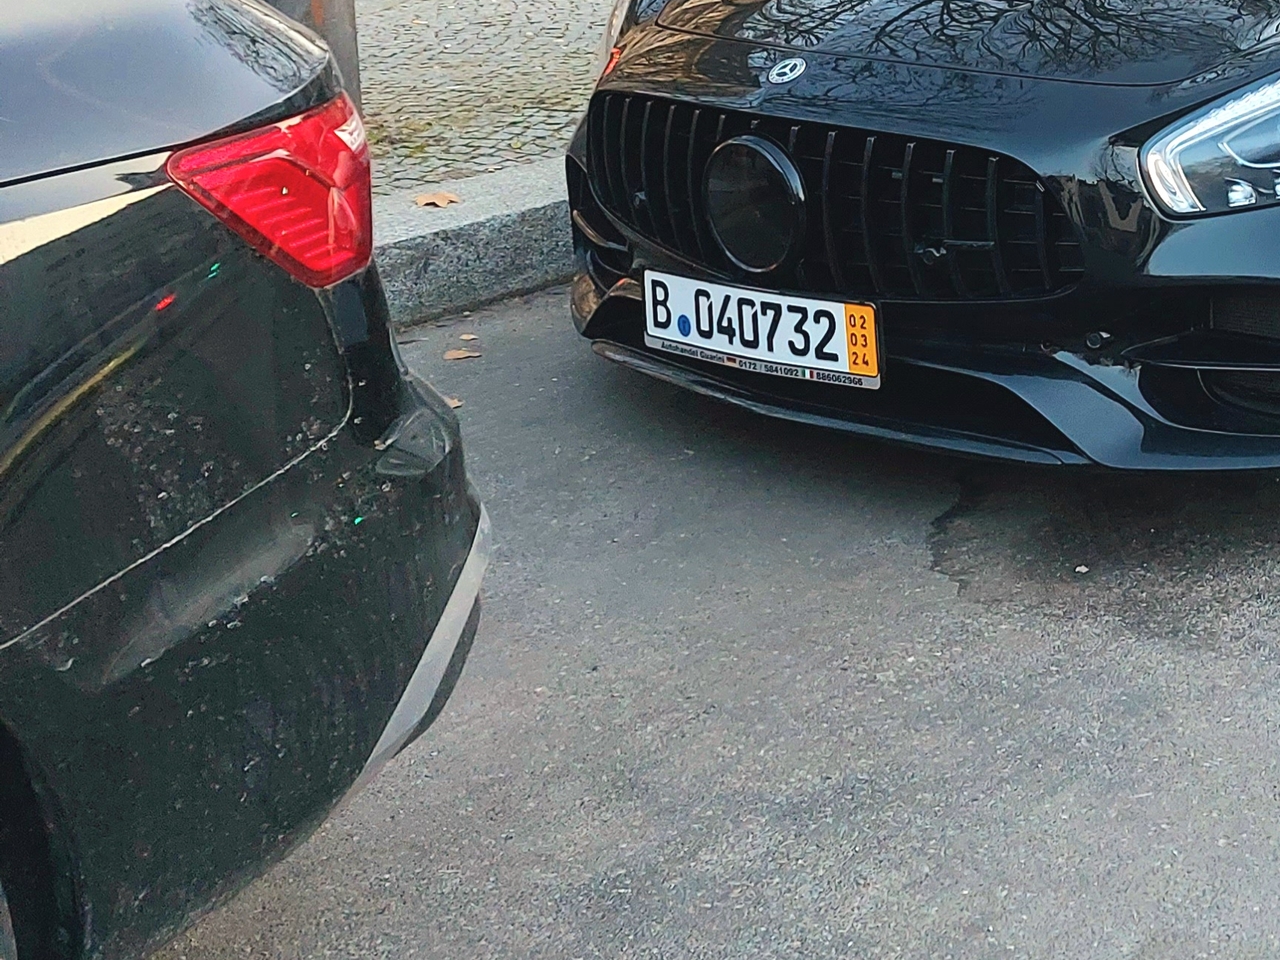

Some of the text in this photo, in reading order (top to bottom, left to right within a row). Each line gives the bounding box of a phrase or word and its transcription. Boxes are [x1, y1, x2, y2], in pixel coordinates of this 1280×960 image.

[651, 279, 840, 362] B 040732
[849, 314, 867, 330] 02
[850, 332, 868, 348] 03
[852, 351, 869, 367] 24
